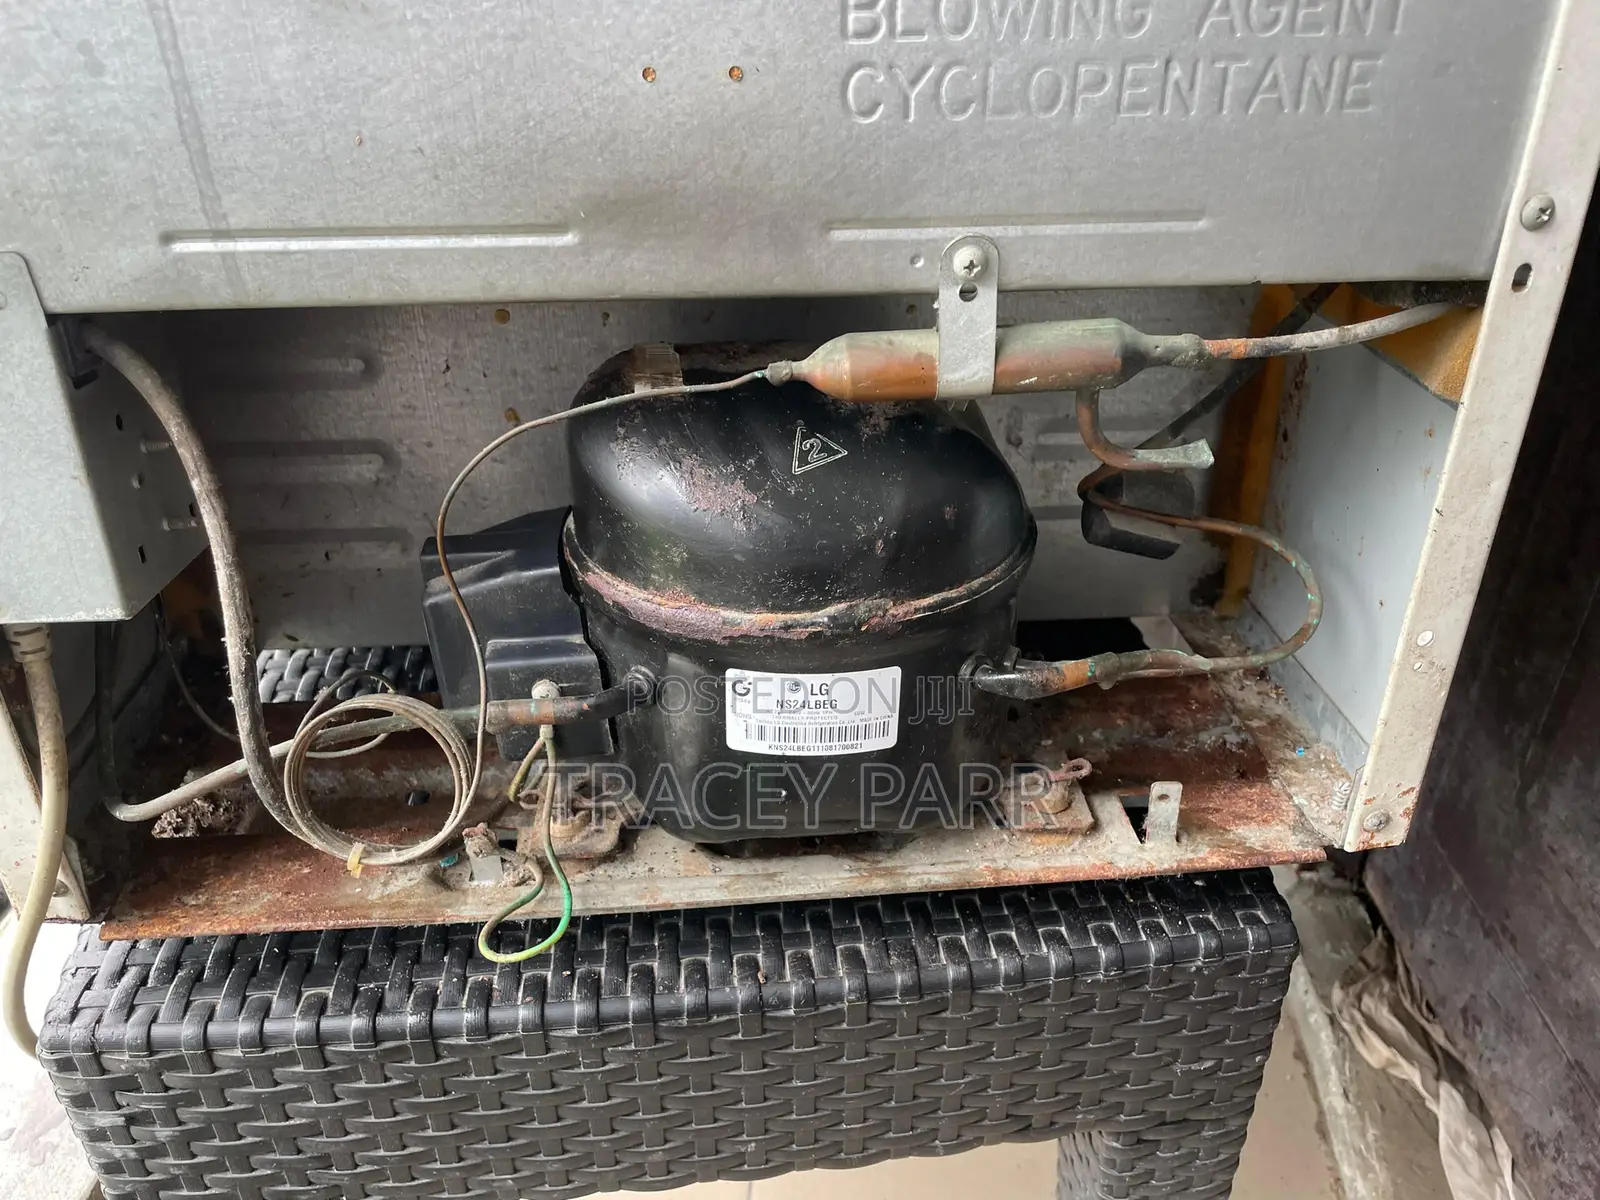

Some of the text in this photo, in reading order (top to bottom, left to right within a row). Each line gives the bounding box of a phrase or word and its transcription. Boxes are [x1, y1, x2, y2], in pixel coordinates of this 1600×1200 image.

[842, 0, 1153, 45] BLOWING
[842, 55, 1384, 123] CYCLOPENTANE
[810, 683, 830, 696] LG
[776, 699, 838, 710] NS24LBEG
